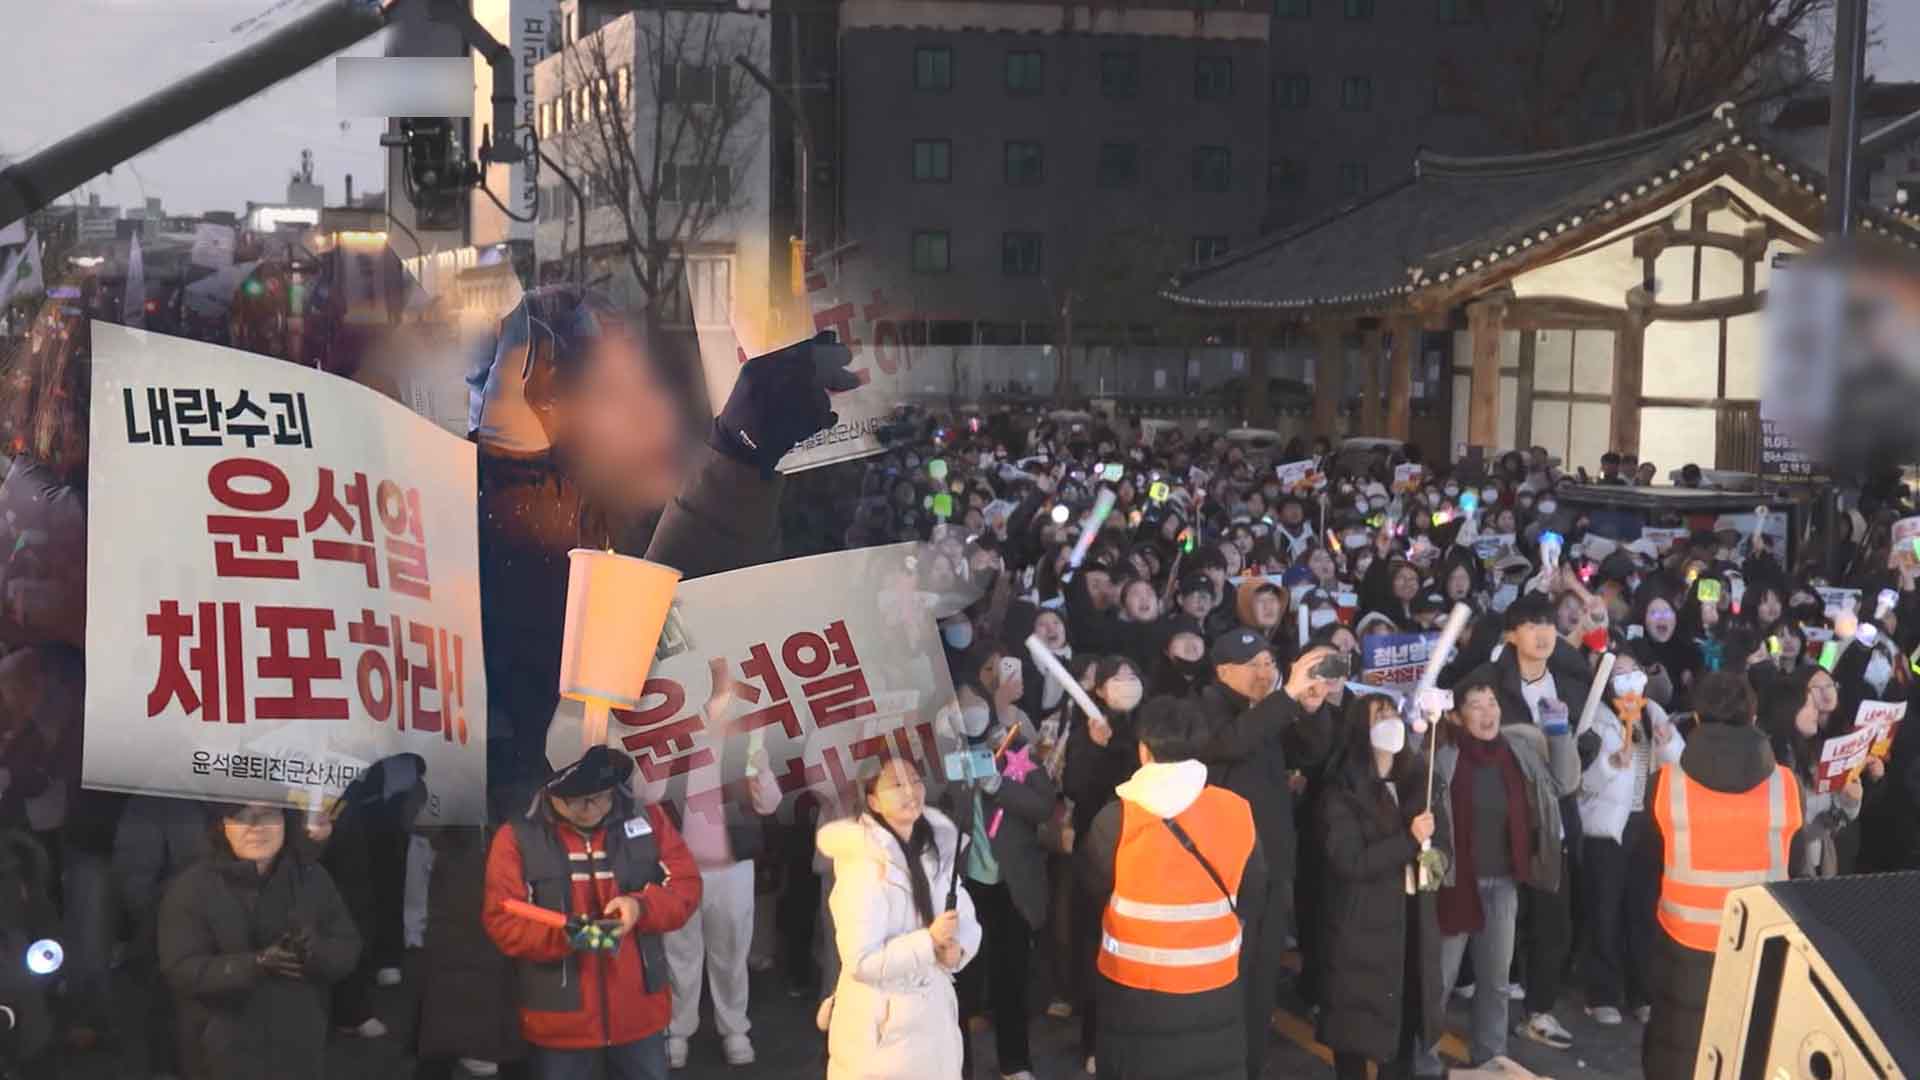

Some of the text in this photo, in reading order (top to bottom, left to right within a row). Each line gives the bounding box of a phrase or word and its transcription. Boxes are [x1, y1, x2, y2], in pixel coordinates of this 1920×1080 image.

[123, 387, 313, 449] 내란수괴
[206, 457, 433, 601] 윤석열
[146, 600, 468, 746] 체포하라!
[610, 619, 878, 785] 윤석열
